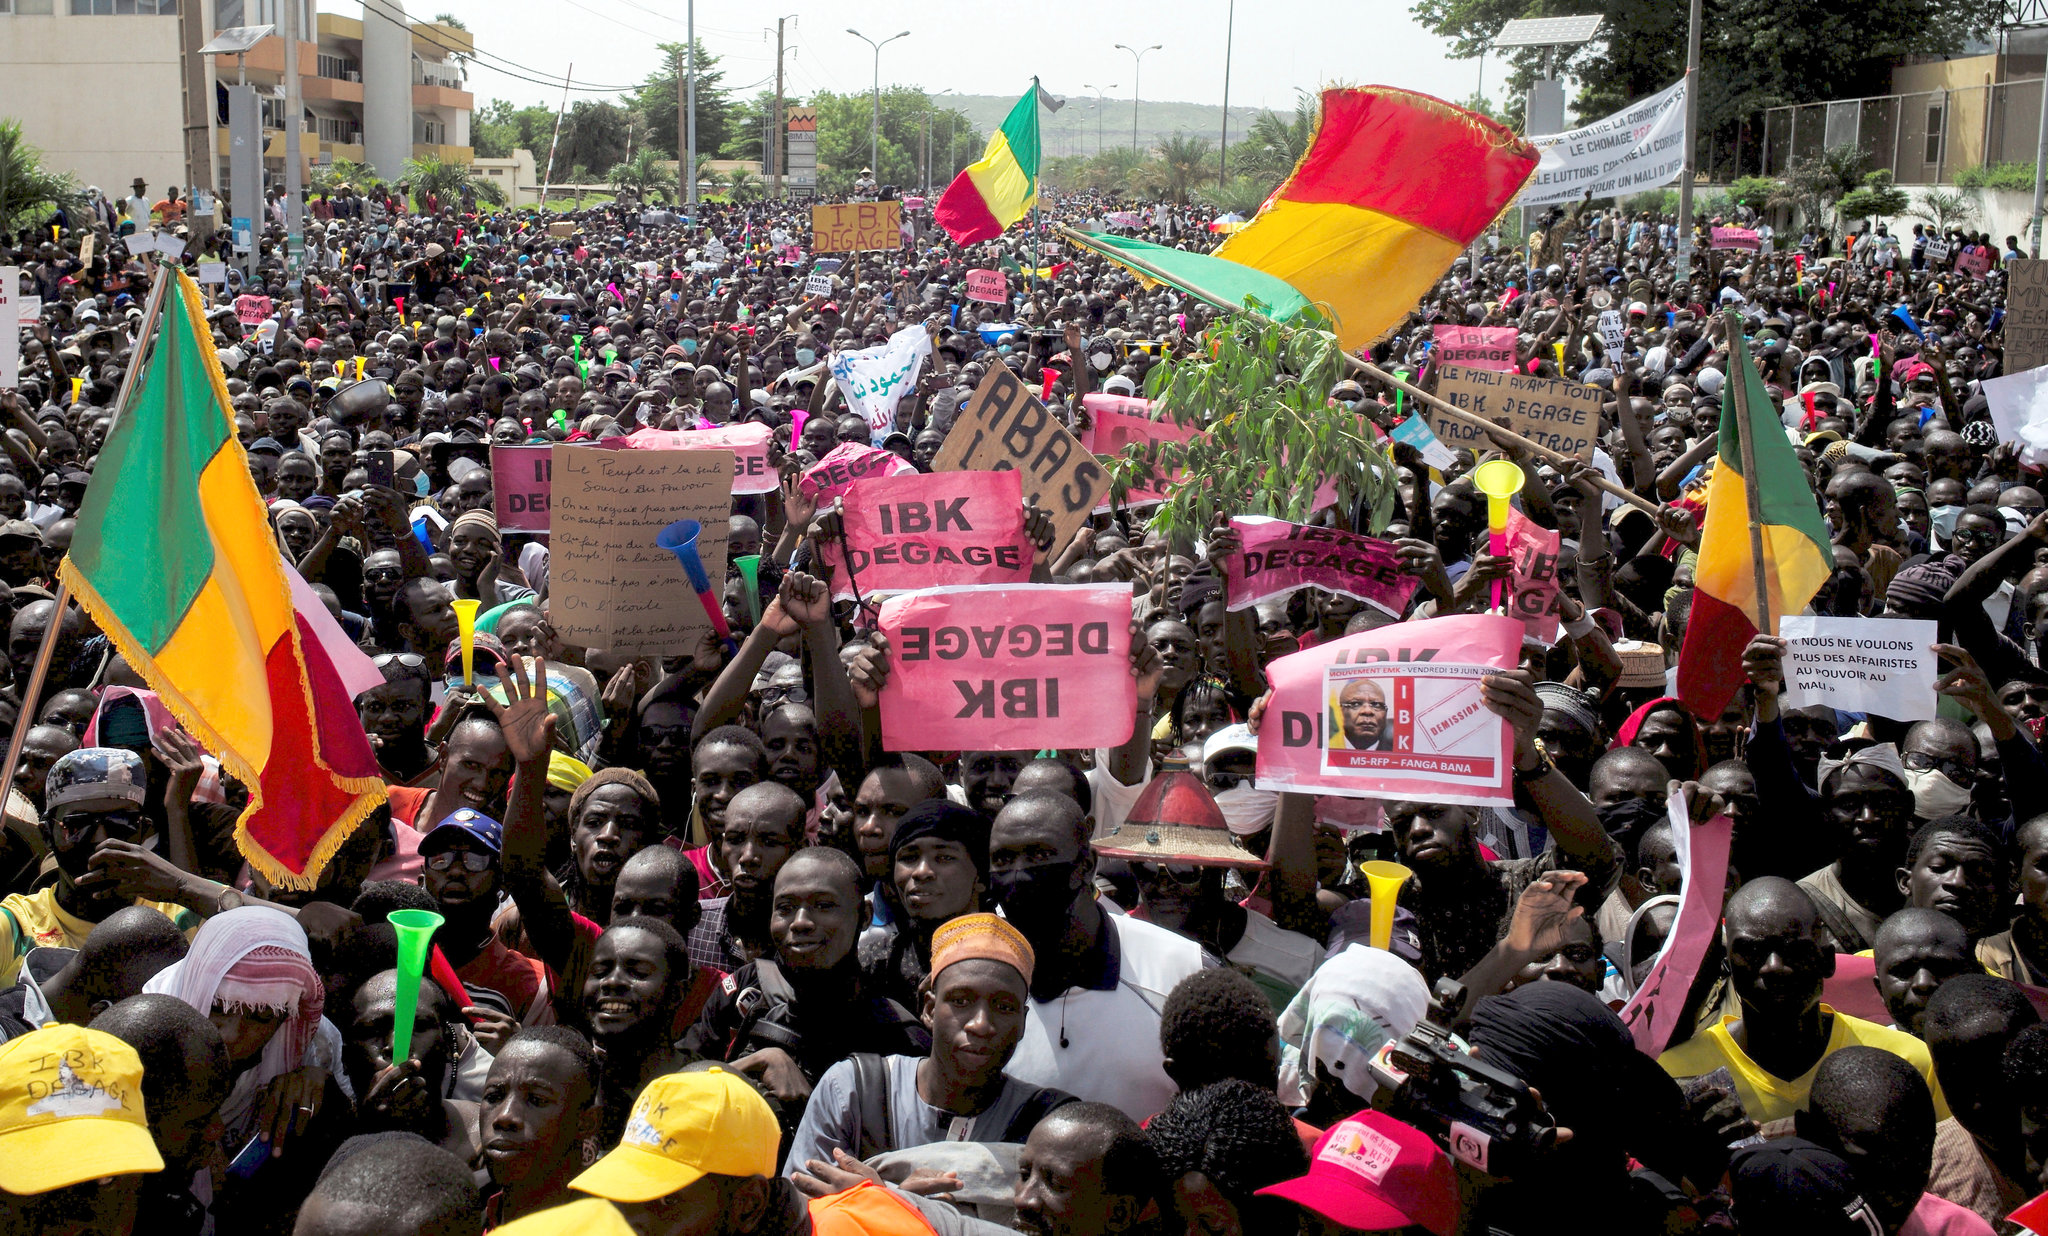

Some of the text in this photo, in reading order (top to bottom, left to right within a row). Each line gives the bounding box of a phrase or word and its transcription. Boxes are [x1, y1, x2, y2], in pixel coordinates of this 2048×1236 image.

[1612, 117, 1626, 130] LA
[1569, 144, 1585, 157] LE
[1587, 131, 1633, 153] CHOMAGE
[1553, 164, 1599, 184] LUTTONS
[1638, 144, 1653, 158] LA
[1618, 174, 1632, 189] UN
[1633, 167, 1658, 185] MALI
[813, 228, 899, 252] DEGAGE
[1928, 240, 1948, 252] IBK
[806, 284, 831, 294] DEGAGE
[810, 276, 829, 285] IBK
[979, 275, 998, 286] IBK
[969, 285, 1004, 297] DEGAGE
[1459, 333, 1495, 346] IBK
[1443, 349, 1512, 362] DEGAGE
[1442, 367, 1459, 380] LE
[1509, 376, 1559, 395] AVANT
[1563, 383, 1602, 403] TOUT
[1450, 391, 1588, 426] IBK DEGAGE
[1437, 418, 1484, 441] TROP
[1535, 431, 1588, 454] TROP
[566, 453, 591, 475] Le
[648, 465, 669, 476] est
[672, 464, 692, 476] la
[562, 496, 576, 510] On
[641, 504, 666, 520] pas
[669, 504, 691, 512] avec
[878, 496, 973, 536] IBK
[1243, 549, 1397, 587] DEGAGE
[564, 595, 589, 610] On
[901, 621, 1109, 661] DEGAGE
[1801, 637, 1835, 647] NOUS
[1837, 638, 1853, 648] NE
[1855, 639, 1914, 651] VOULONS
[1793, 653, 1918, 670] PLUS DES AFFAIRISTES
[1329, 667, 1382, 678] MOUVEMENT
[1383, 666, 1400, 674] EMK
[1407, 666, 1448, 674] VENDREDI
[1796, 667, 1887, 682] AU POUVOIR AU
[1798, 682, 1826, 691] MALI
[952, 677, 1060, 719] IBK
[1429, 702, 1480, 737] DEMISSION
[1350, 756, 1390, 767] M5-RFP
[1400, 758, 1439, 771] FANGA
[1440, 762, 1472, 774] BANA
[28, 1049, 105, 1075] IBK
[27, 1078, 132, 1112] DEGAGE
[1369, 1148, 1391, 1165] RFP
